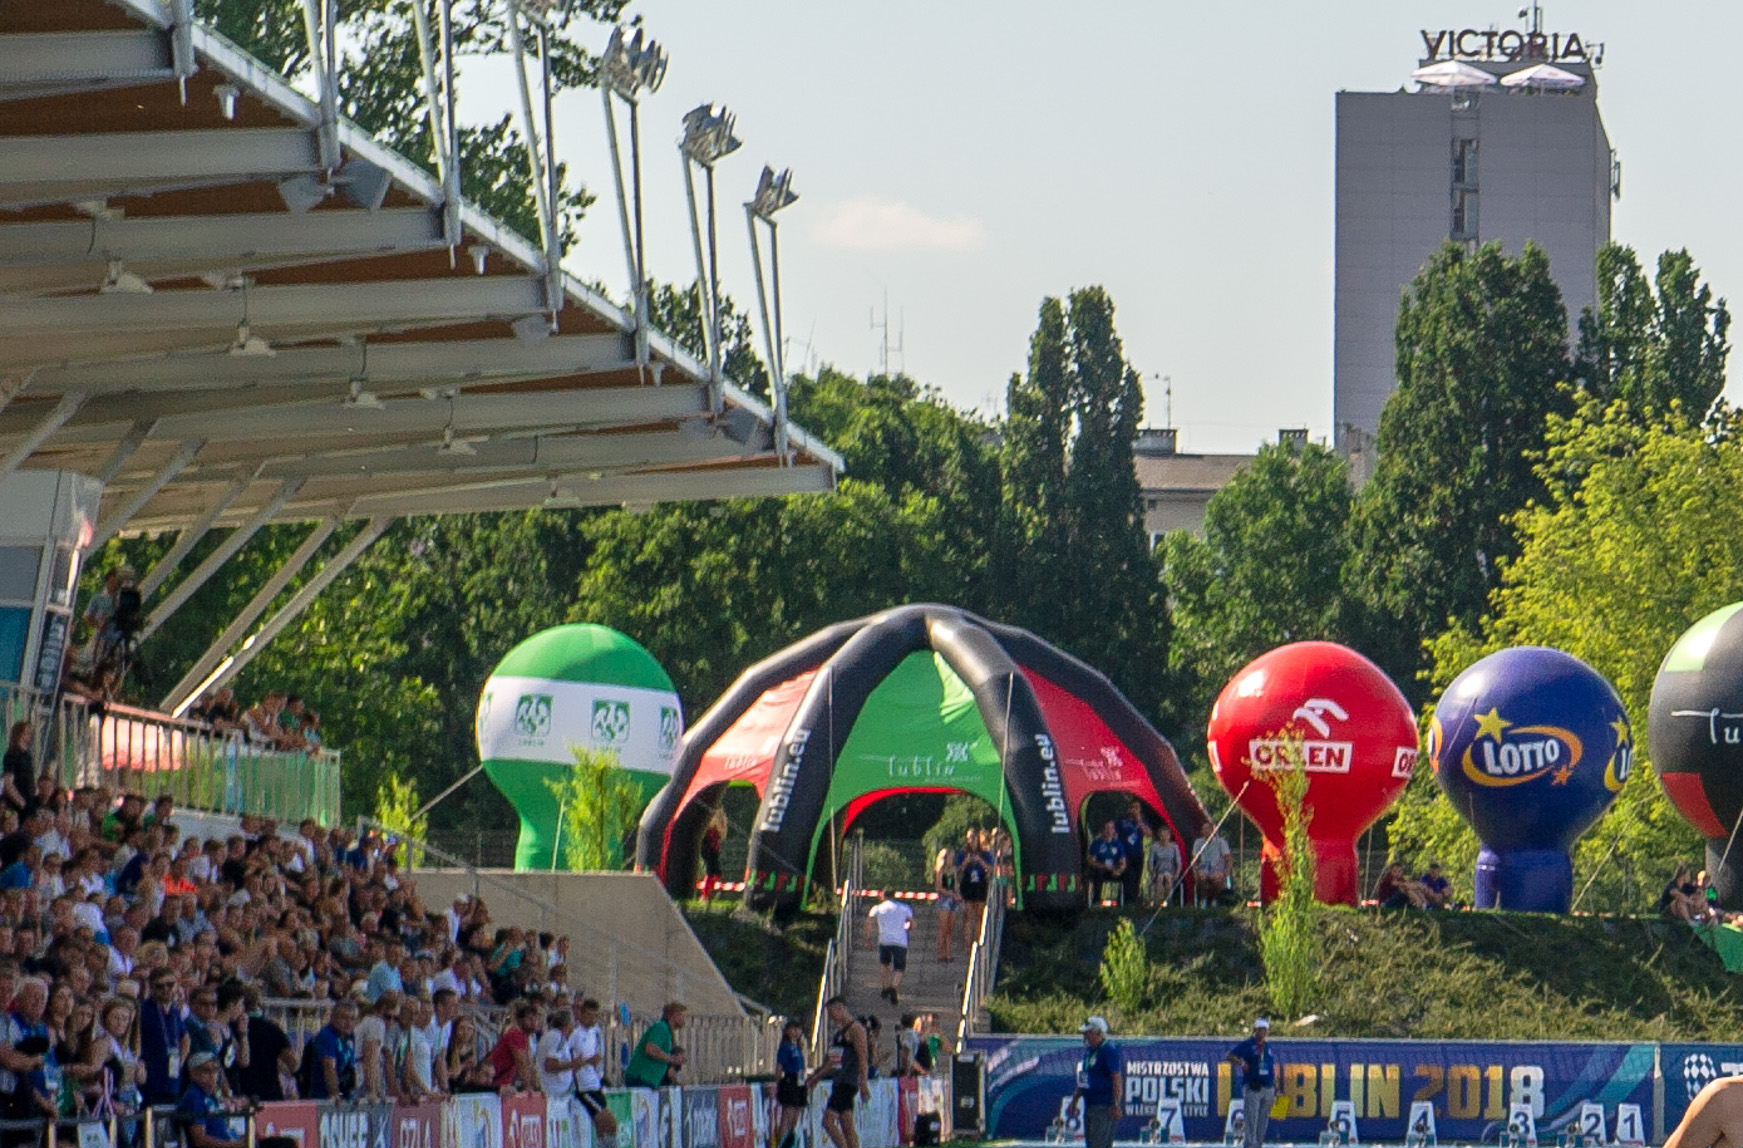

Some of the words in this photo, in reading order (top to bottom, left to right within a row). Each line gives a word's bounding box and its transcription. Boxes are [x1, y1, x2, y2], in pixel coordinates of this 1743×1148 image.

[1420, 29, 1588, 60] VICTORIA
[1254, 745, 1347, 769] OREN
[1484, 738, 1560, 774] LOTTO
[760, 728, 811, 833] lublin.eu
[1034, 733, 1071, 834] lublin.eu
[1125, 1060, 1210, 1077] MISTRZOSTWA
[1125, 1076, 1210, 1103] POLSKI
[1217, 1062, 1400, 1119] LBLIN
[1160, 1106, 1178, 1134] 7
[1513, 1111, 1530, 1134] 3
[1583, 1112, 1601, 1138] 2
[1623, 1113, 1635, 1138] 1
